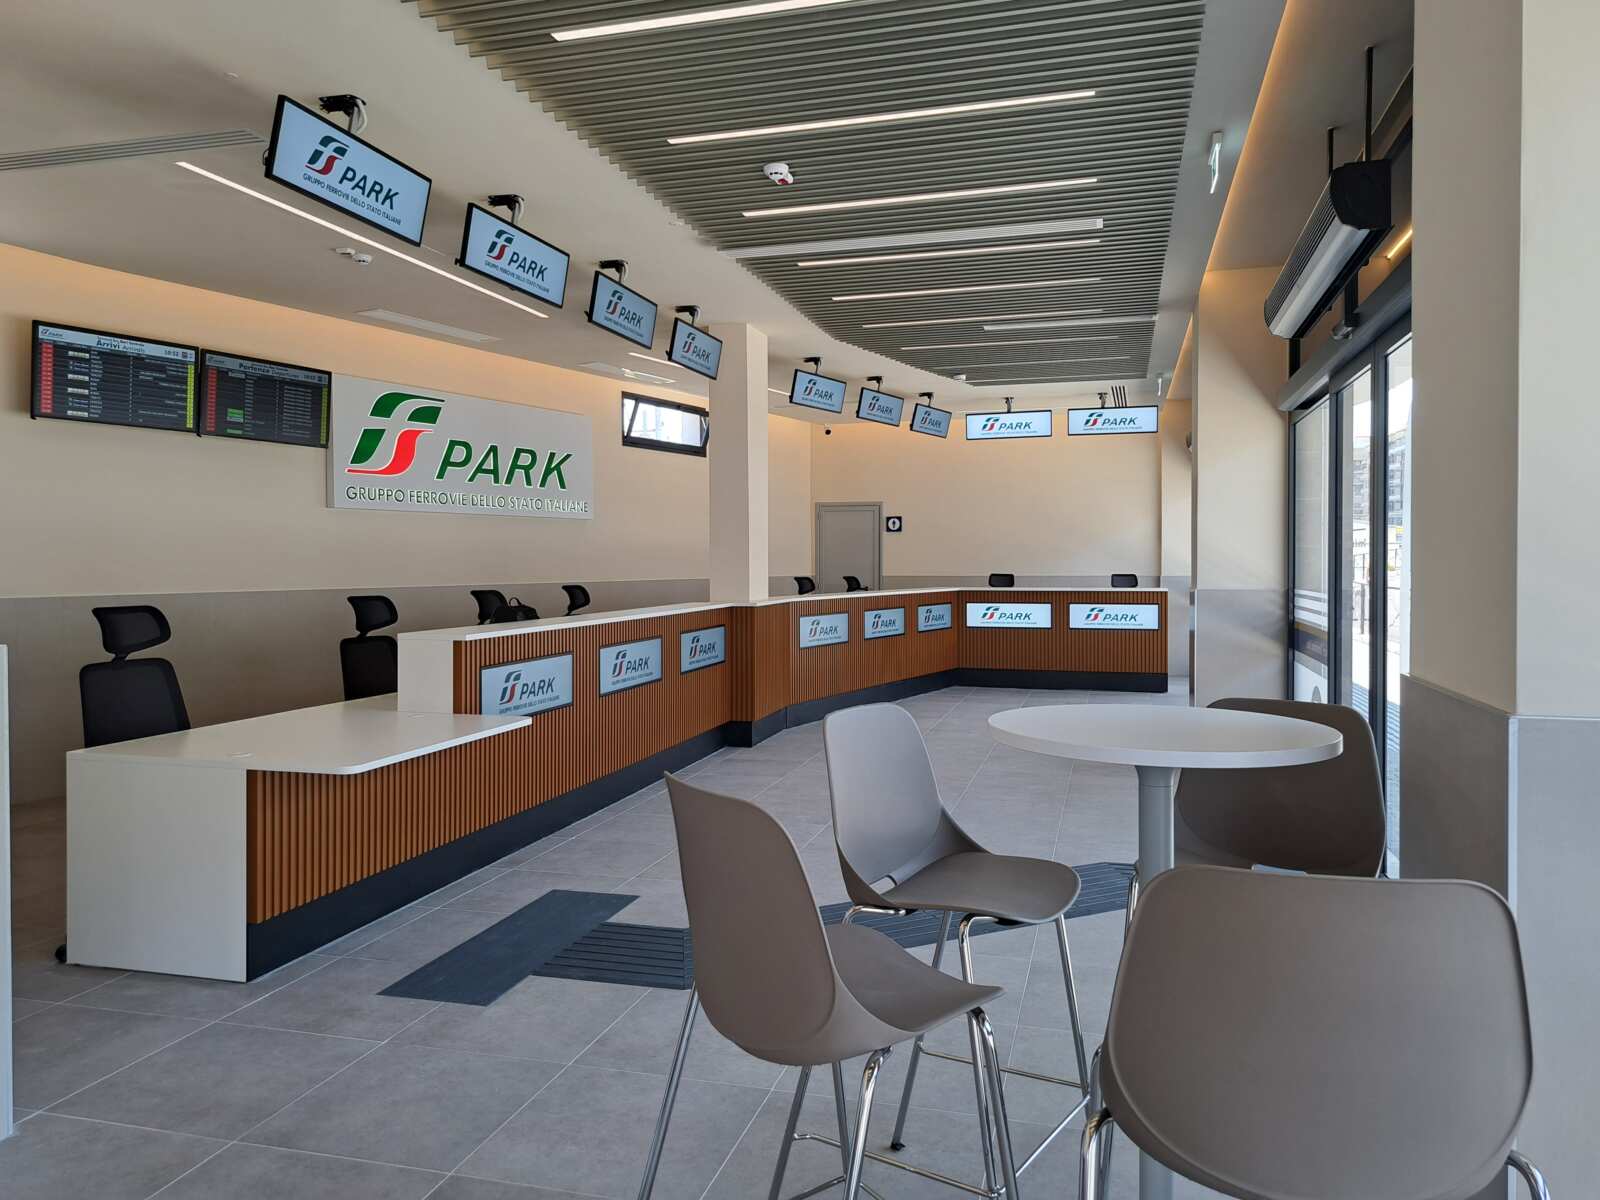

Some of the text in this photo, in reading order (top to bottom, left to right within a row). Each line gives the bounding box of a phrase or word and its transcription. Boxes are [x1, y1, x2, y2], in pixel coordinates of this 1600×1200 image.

[302, 173, 326, 189] GRUPPO
[338, 166, 400, 210] PARK
[507, 251, 548, 282] PARK
[618, 306, 645, 329] PARK
[96, 339, 121, 350] Arrivi
[691, 346, 712, 364] PARK
[814, 389, 835, 402] PARK
[876, 404, 894, 417] PARK
[927, 418, 942, 429] PARK
[999, 421, 1033, 431] PARK
[1101, 416, 1139, 427] PARK
[434, 439, 573, 491] PARK
[345, 486, 589, 513] GRUPPO FERROVIE DELLO STATO ITALIANE
[931, 613, 945, 622] PARK
[998, 611, 1033, 621] PARK
[1102, 613, 1139, 622] PARK
[880, 618, 897, 629] PARK
[818, 625, 839, 637] PARK
[698, 642, 718, 656] PARK
[625, 655, 651, 675] PARK
[519, 676, 556, 701] PARK
